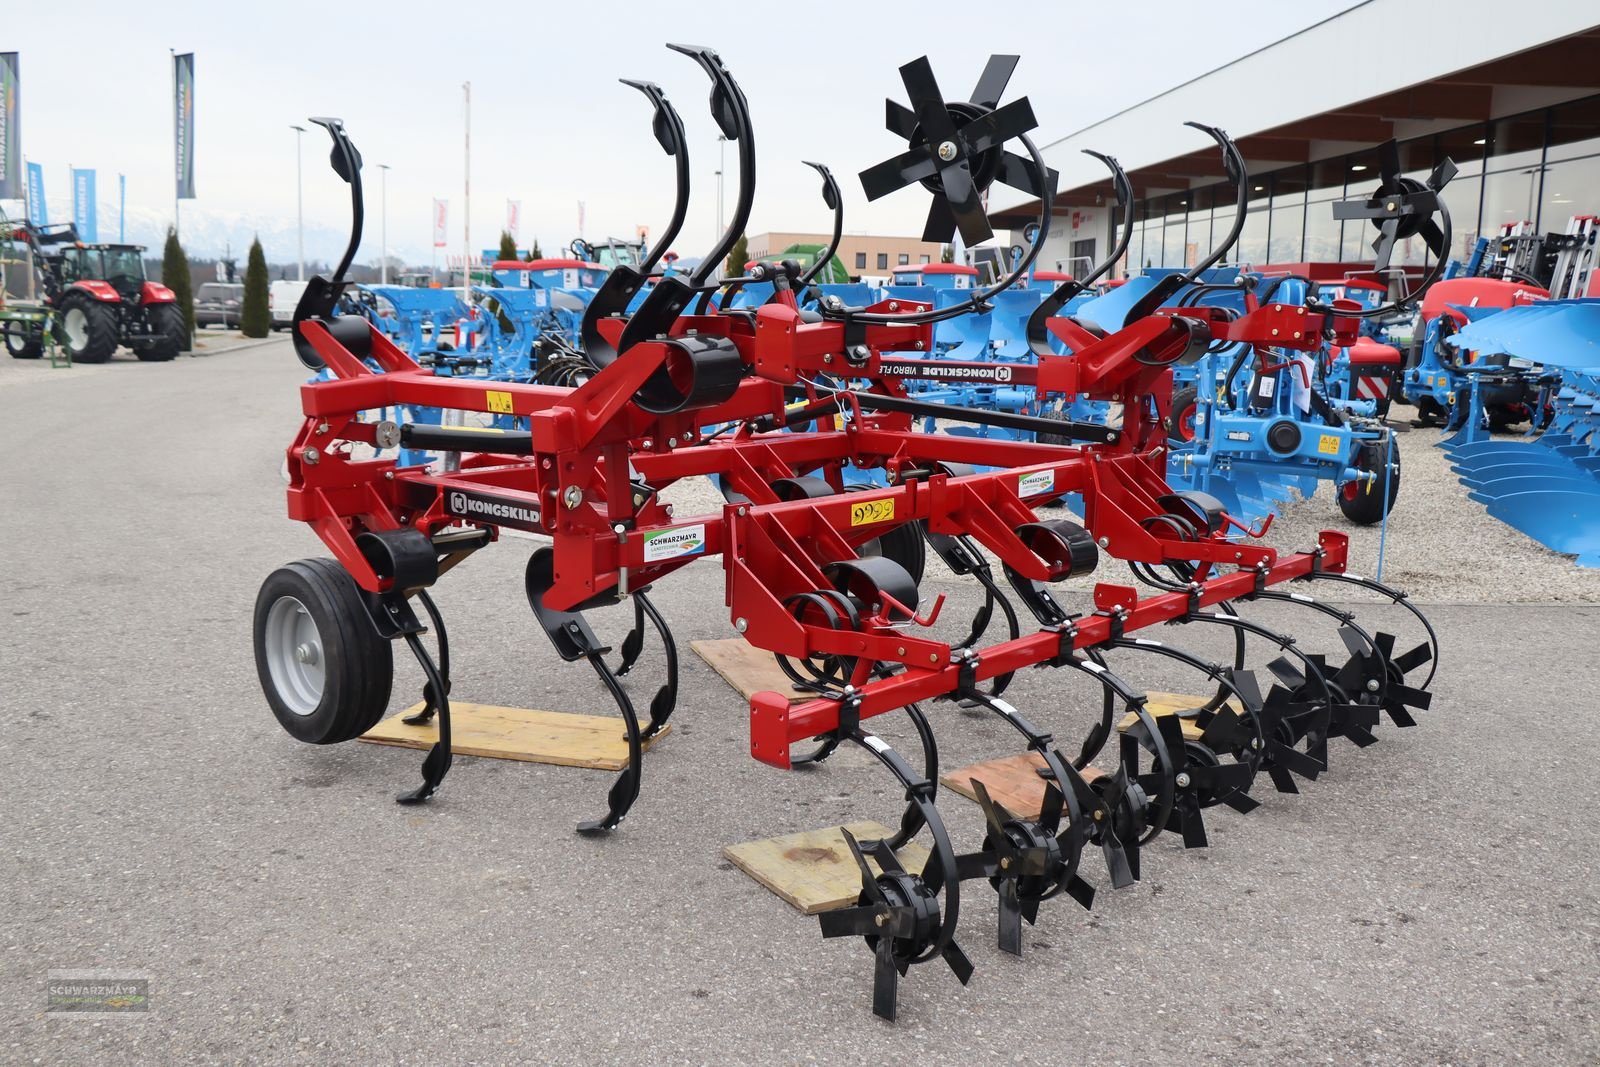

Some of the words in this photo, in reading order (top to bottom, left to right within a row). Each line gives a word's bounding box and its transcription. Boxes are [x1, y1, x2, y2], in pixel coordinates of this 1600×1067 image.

[78, 176, 87, 223] LEMKEN
[878, 365, 893, 375] FLE
[893, 365, 917, 375] VIBRO
[922, 367, 995, 378] KONGSKILDE
[467, 498, 542, 524] KONGSKILD
[650, 533, 697, 546] SCHWARZMAYR
